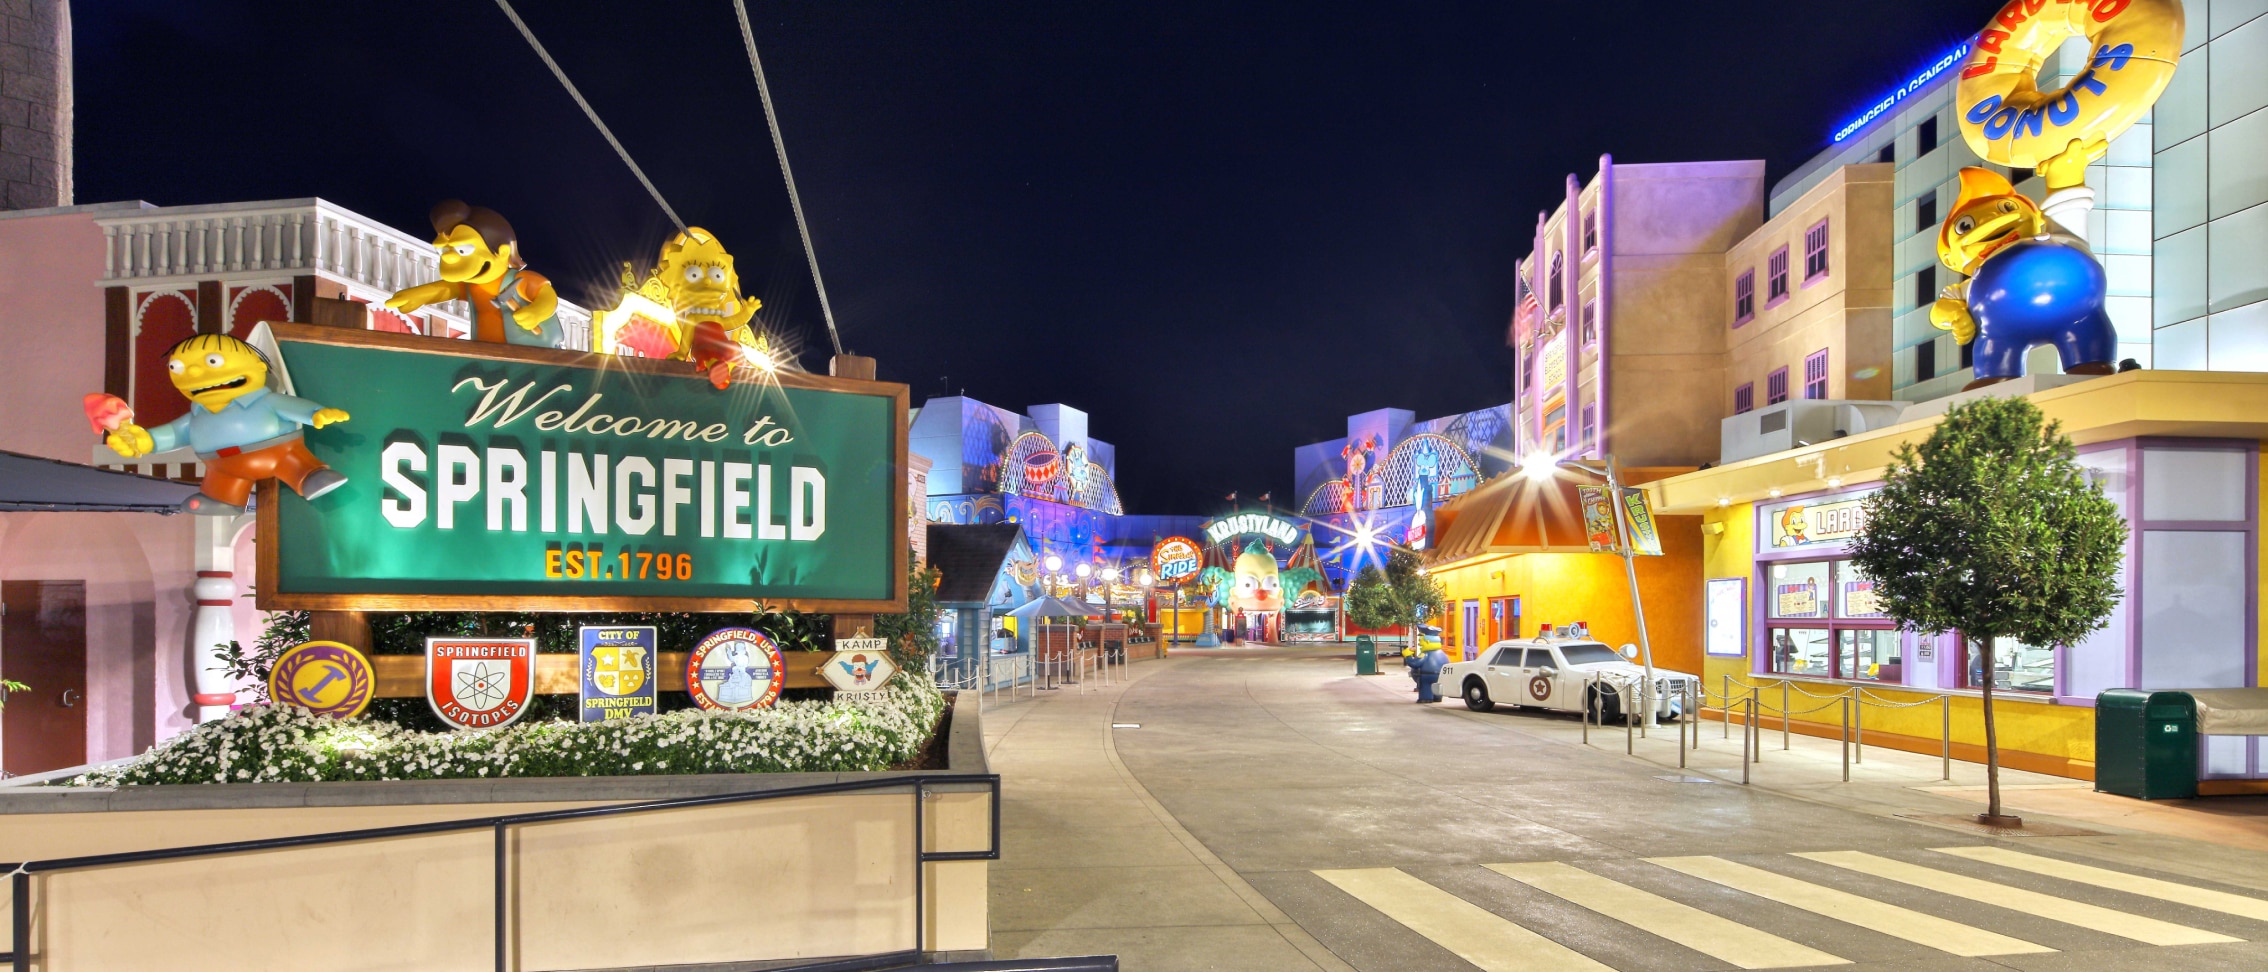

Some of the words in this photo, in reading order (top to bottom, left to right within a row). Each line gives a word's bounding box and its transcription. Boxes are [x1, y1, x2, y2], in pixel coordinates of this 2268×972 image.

[1966, 43, 2134, 140] DONUTS
[451, 377, 729, 442] Welcome
[743, 416, 793, 446] to
[382, 441, 826, 541] SPRINGFIELD
[1207, 513, 1298, 544] KRUSTYLAND
[1160, 559, 1197, 580] RIDE
[598, 631, 623, 640] CITY
[625, 631, 640, 640] OF
[695, 630, 758, 658] SPRINGFIELD,
[760, 640, 777, 658] USA
[842, 639, 882, 650] KAMP
[437, 646, 526, 657] SPRINGFIELD
[585, 696, 653, 708] SPRINGFIELD
[837, 692, 886, 701] KRUSTY
[442, 700, 519, 725] ISOTOPES
[605, 708, 633, 719] DMV
